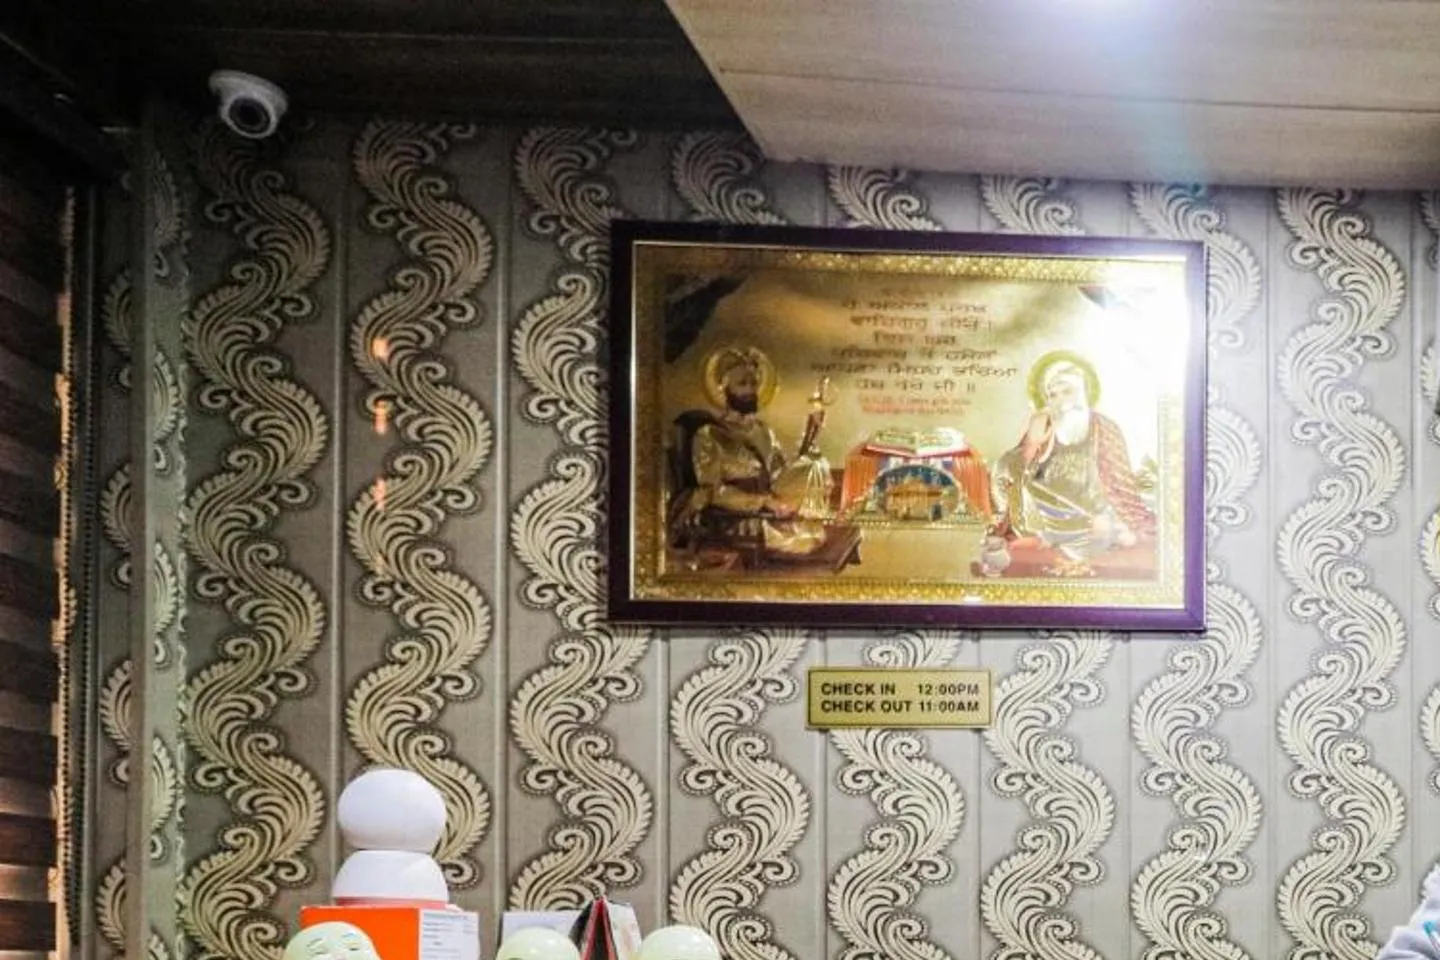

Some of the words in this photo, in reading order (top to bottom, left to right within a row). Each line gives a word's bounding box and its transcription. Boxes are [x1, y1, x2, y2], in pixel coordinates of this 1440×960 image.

[821, 683, 876, 695] CHECK
[880, 683, 896, 695] IN
[917, 683, 980, 696] 12:00PM
[821, 700, 876, 713] CHECK
[880, 700, 913, 713] OUT
[919, 700, 980, 713] 11:00AM
